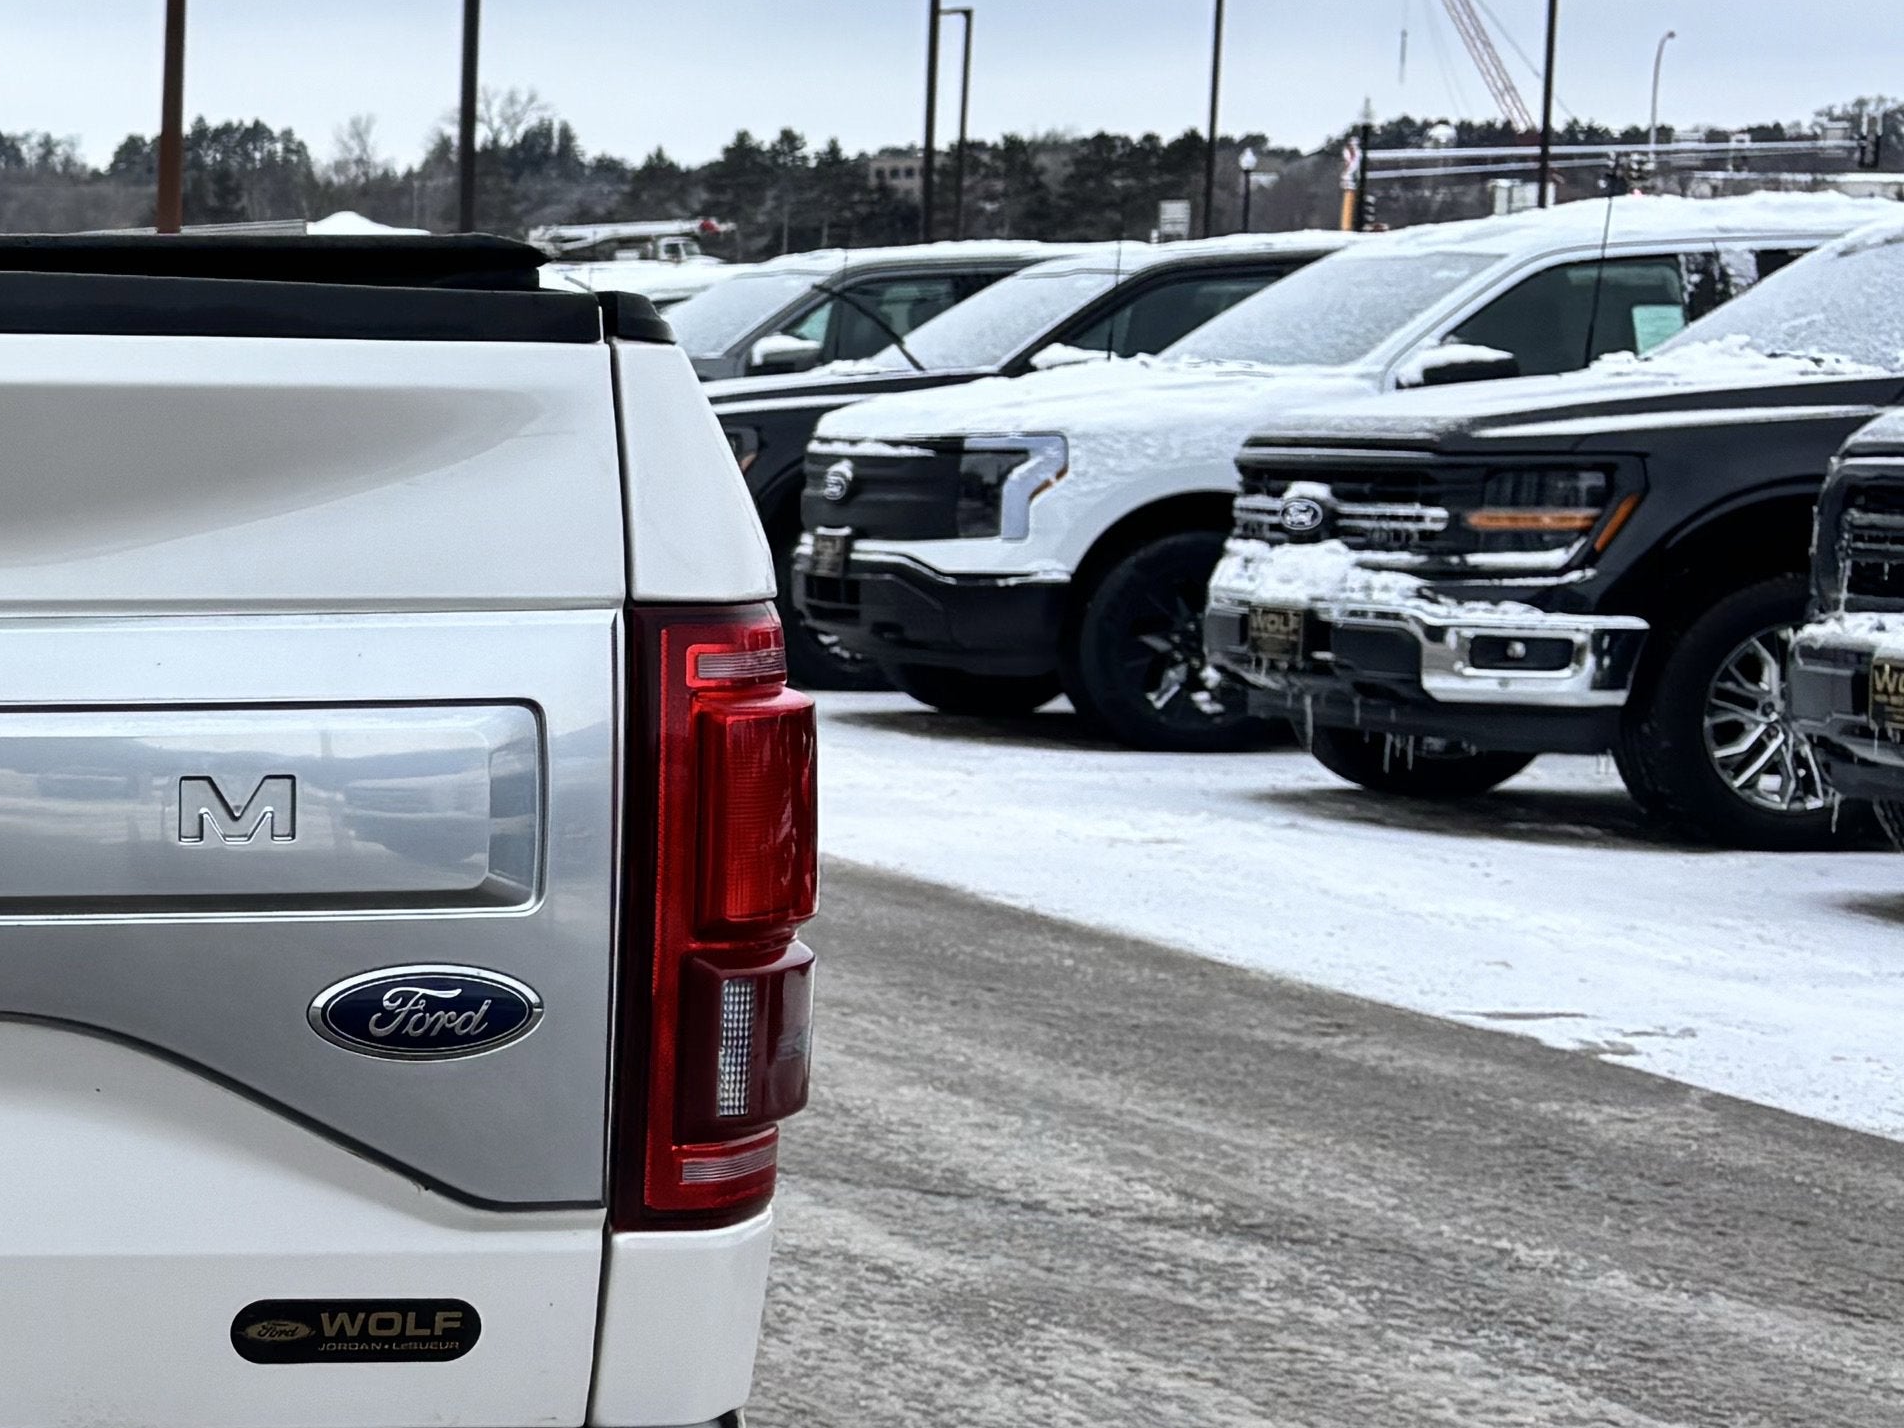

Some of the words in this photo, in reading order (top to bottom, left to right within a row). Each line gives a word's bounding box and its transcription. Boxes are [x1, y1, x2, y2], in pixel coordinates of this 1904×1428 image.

[368, 986, 492, 1037] Ford
[257, 1322, 299, 1339] Ford
[320, 1311, 463, 1338] WOLF
[317, 1341, 383, 1352] JORDAN
